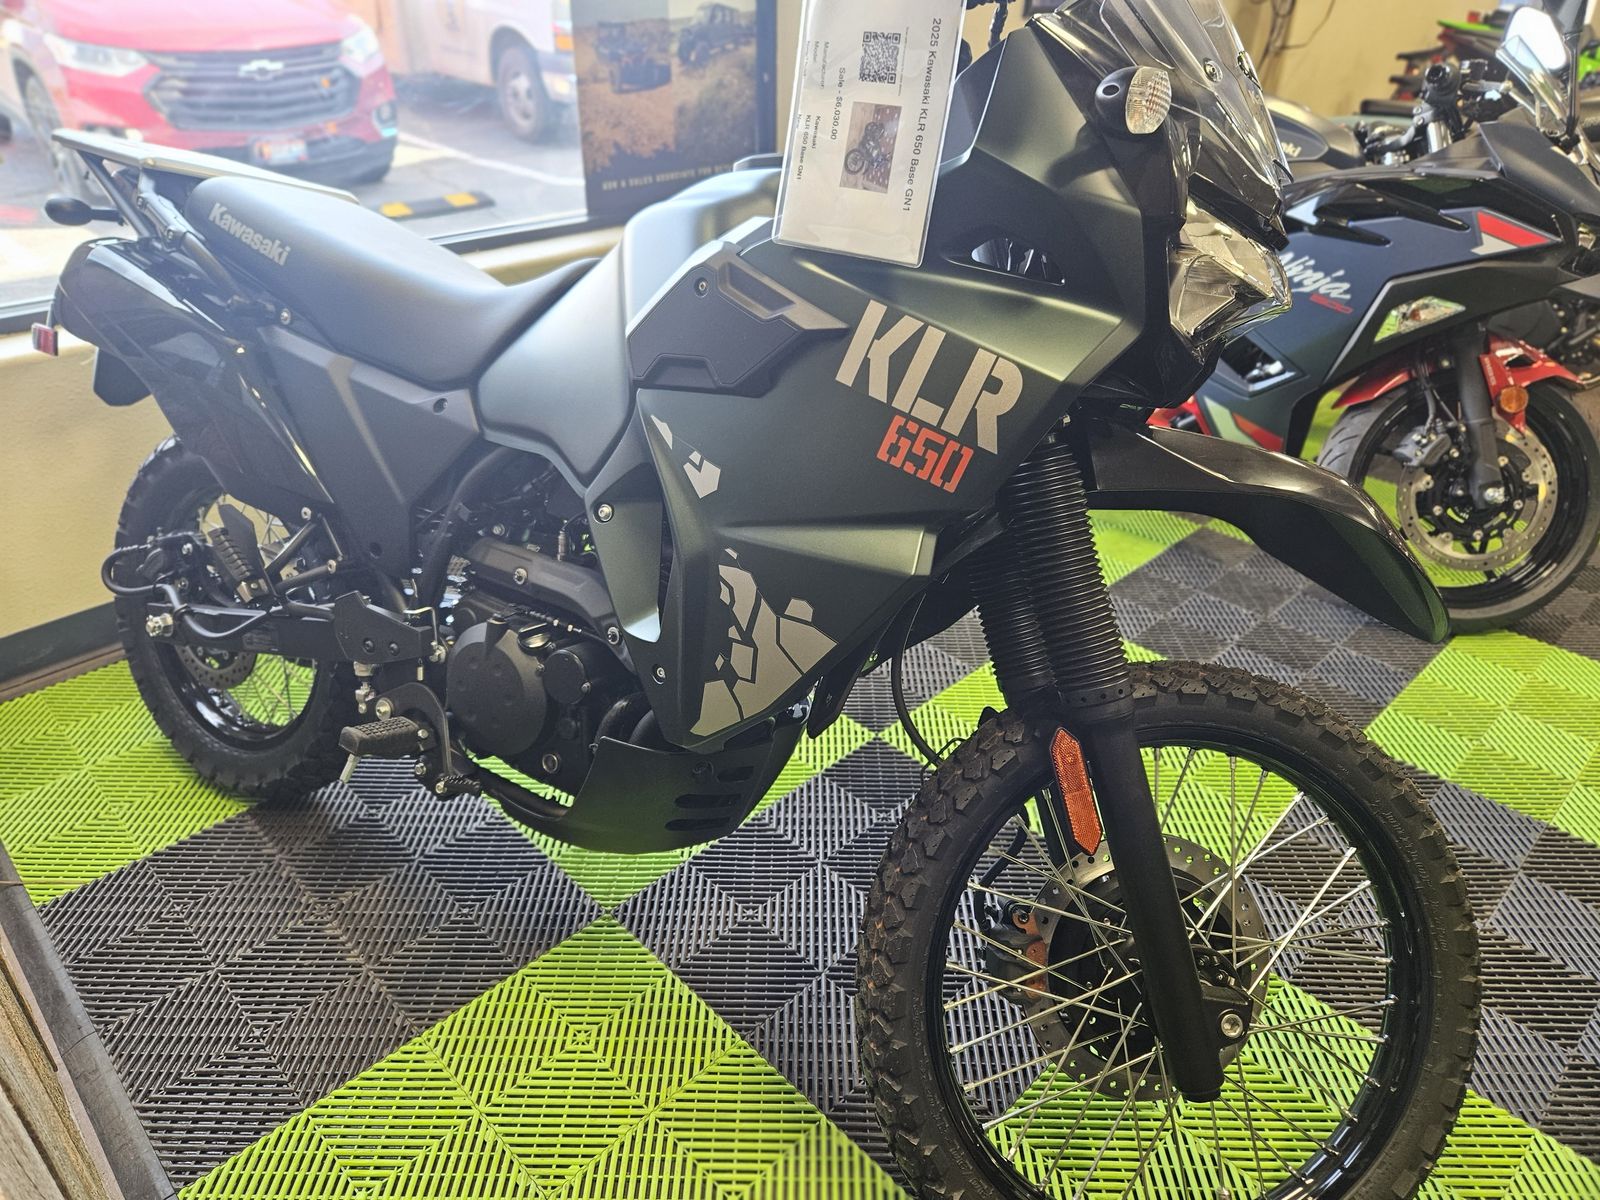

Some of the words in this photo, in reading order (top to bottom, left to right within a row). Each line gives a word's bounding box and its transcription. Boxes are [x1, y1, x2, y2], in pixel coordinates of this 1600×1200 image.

[930, 18, 942, 47] 2025
[837, 67, 846, 88] Sale
[921, 50, 937, 105] Kawasaki
[812, 115, 821, 149] Kawasaki
[830, 96, 843, 140] $6,030.00
[916, 108, 929, 133] KLR
[912, 136, 924, 156] 650
[907, 158, 920, 185] Base
[902, 188, 914, 211] GN1
[208, 202, 291, 266] Kawasaki
[1279, 252, 1352, 299] Ninja
[835, 299, 1024, 455] KLR
[876, 414, 974, 494] 650
